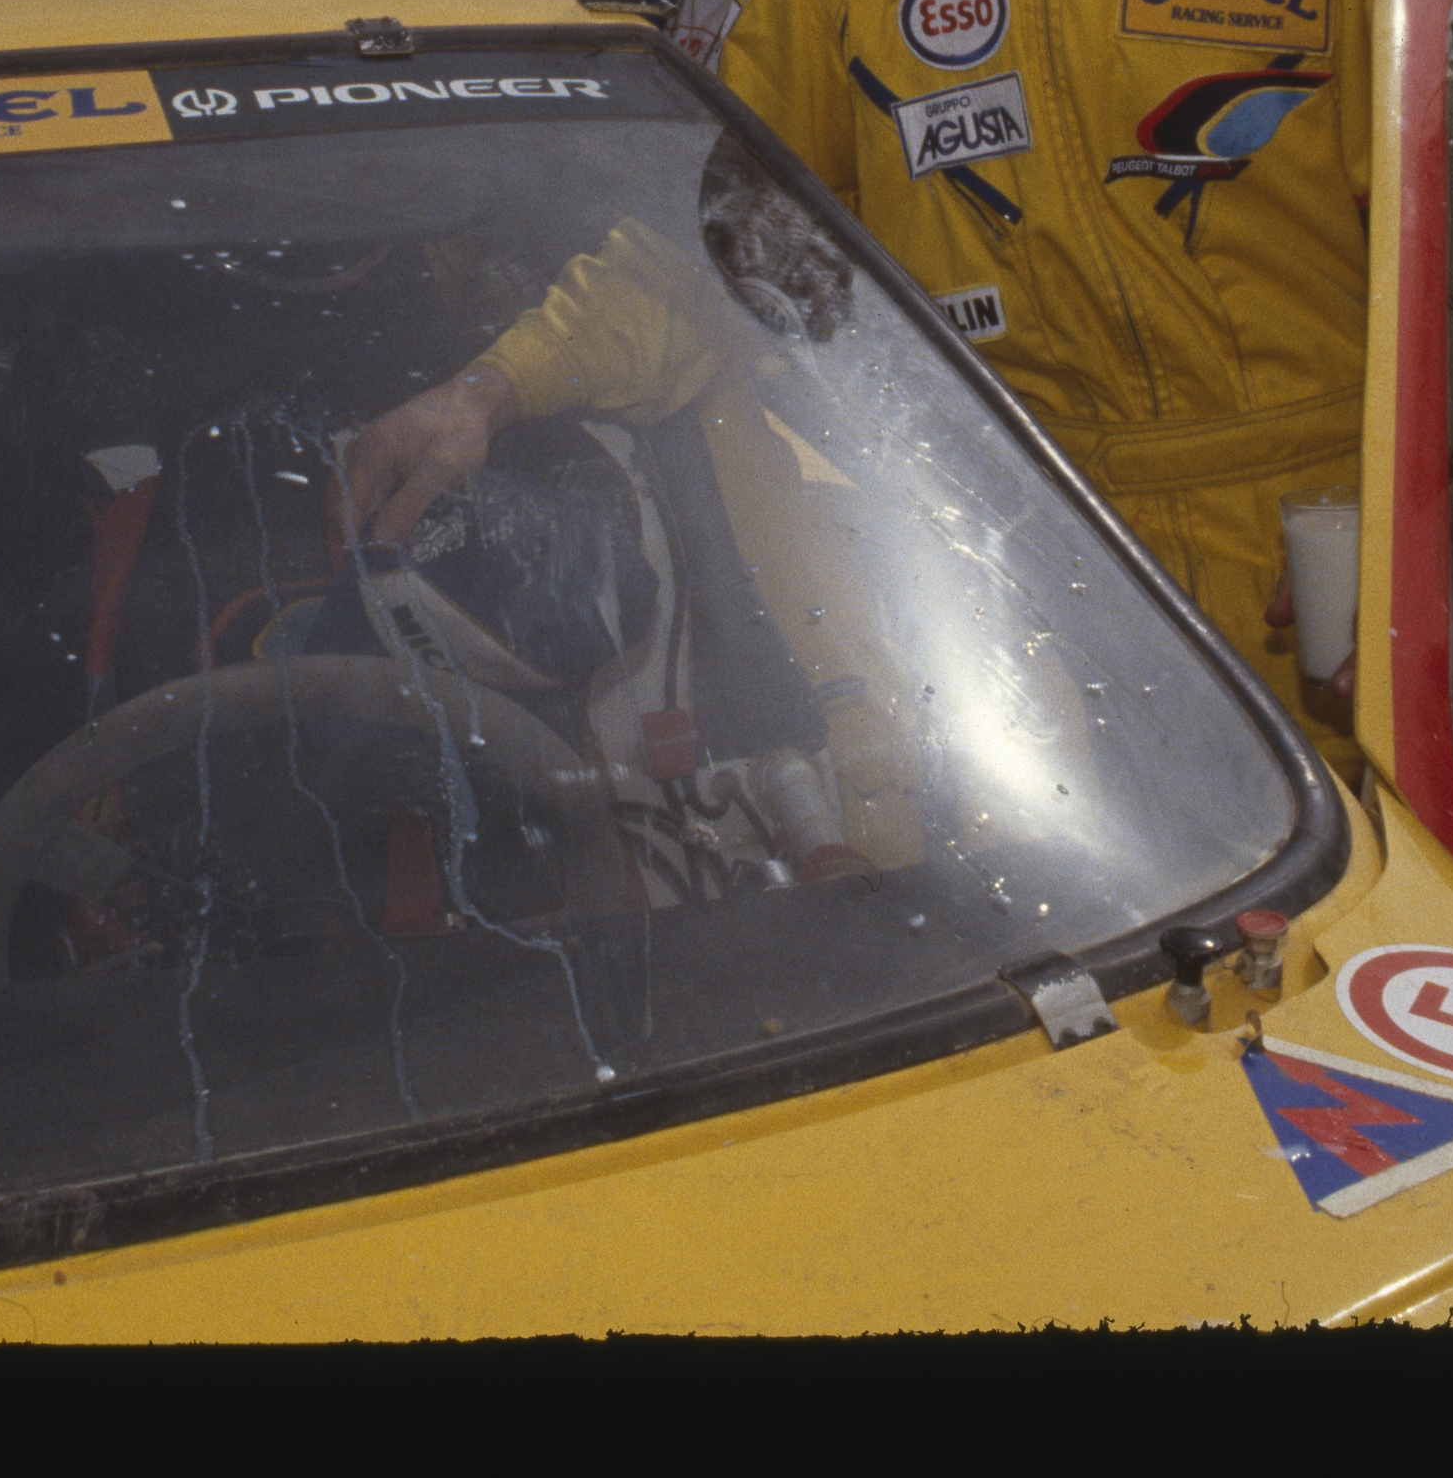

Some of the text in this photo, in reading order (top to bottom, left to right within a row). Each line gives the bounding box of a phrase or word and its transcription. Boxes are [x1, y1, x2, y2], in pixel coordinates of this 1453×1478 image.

[1170, 4, 1285, 30] RACING SERVICE
[253, 77, 610, 110] PIONEER
[924, 95, 971, 119] GRUPPO
[916, 105, 1024, 166] AGUSTA
[1111, 158, 1154, 174] PEUGEOT
[1155, 161, 1197, 177] TALBOT
